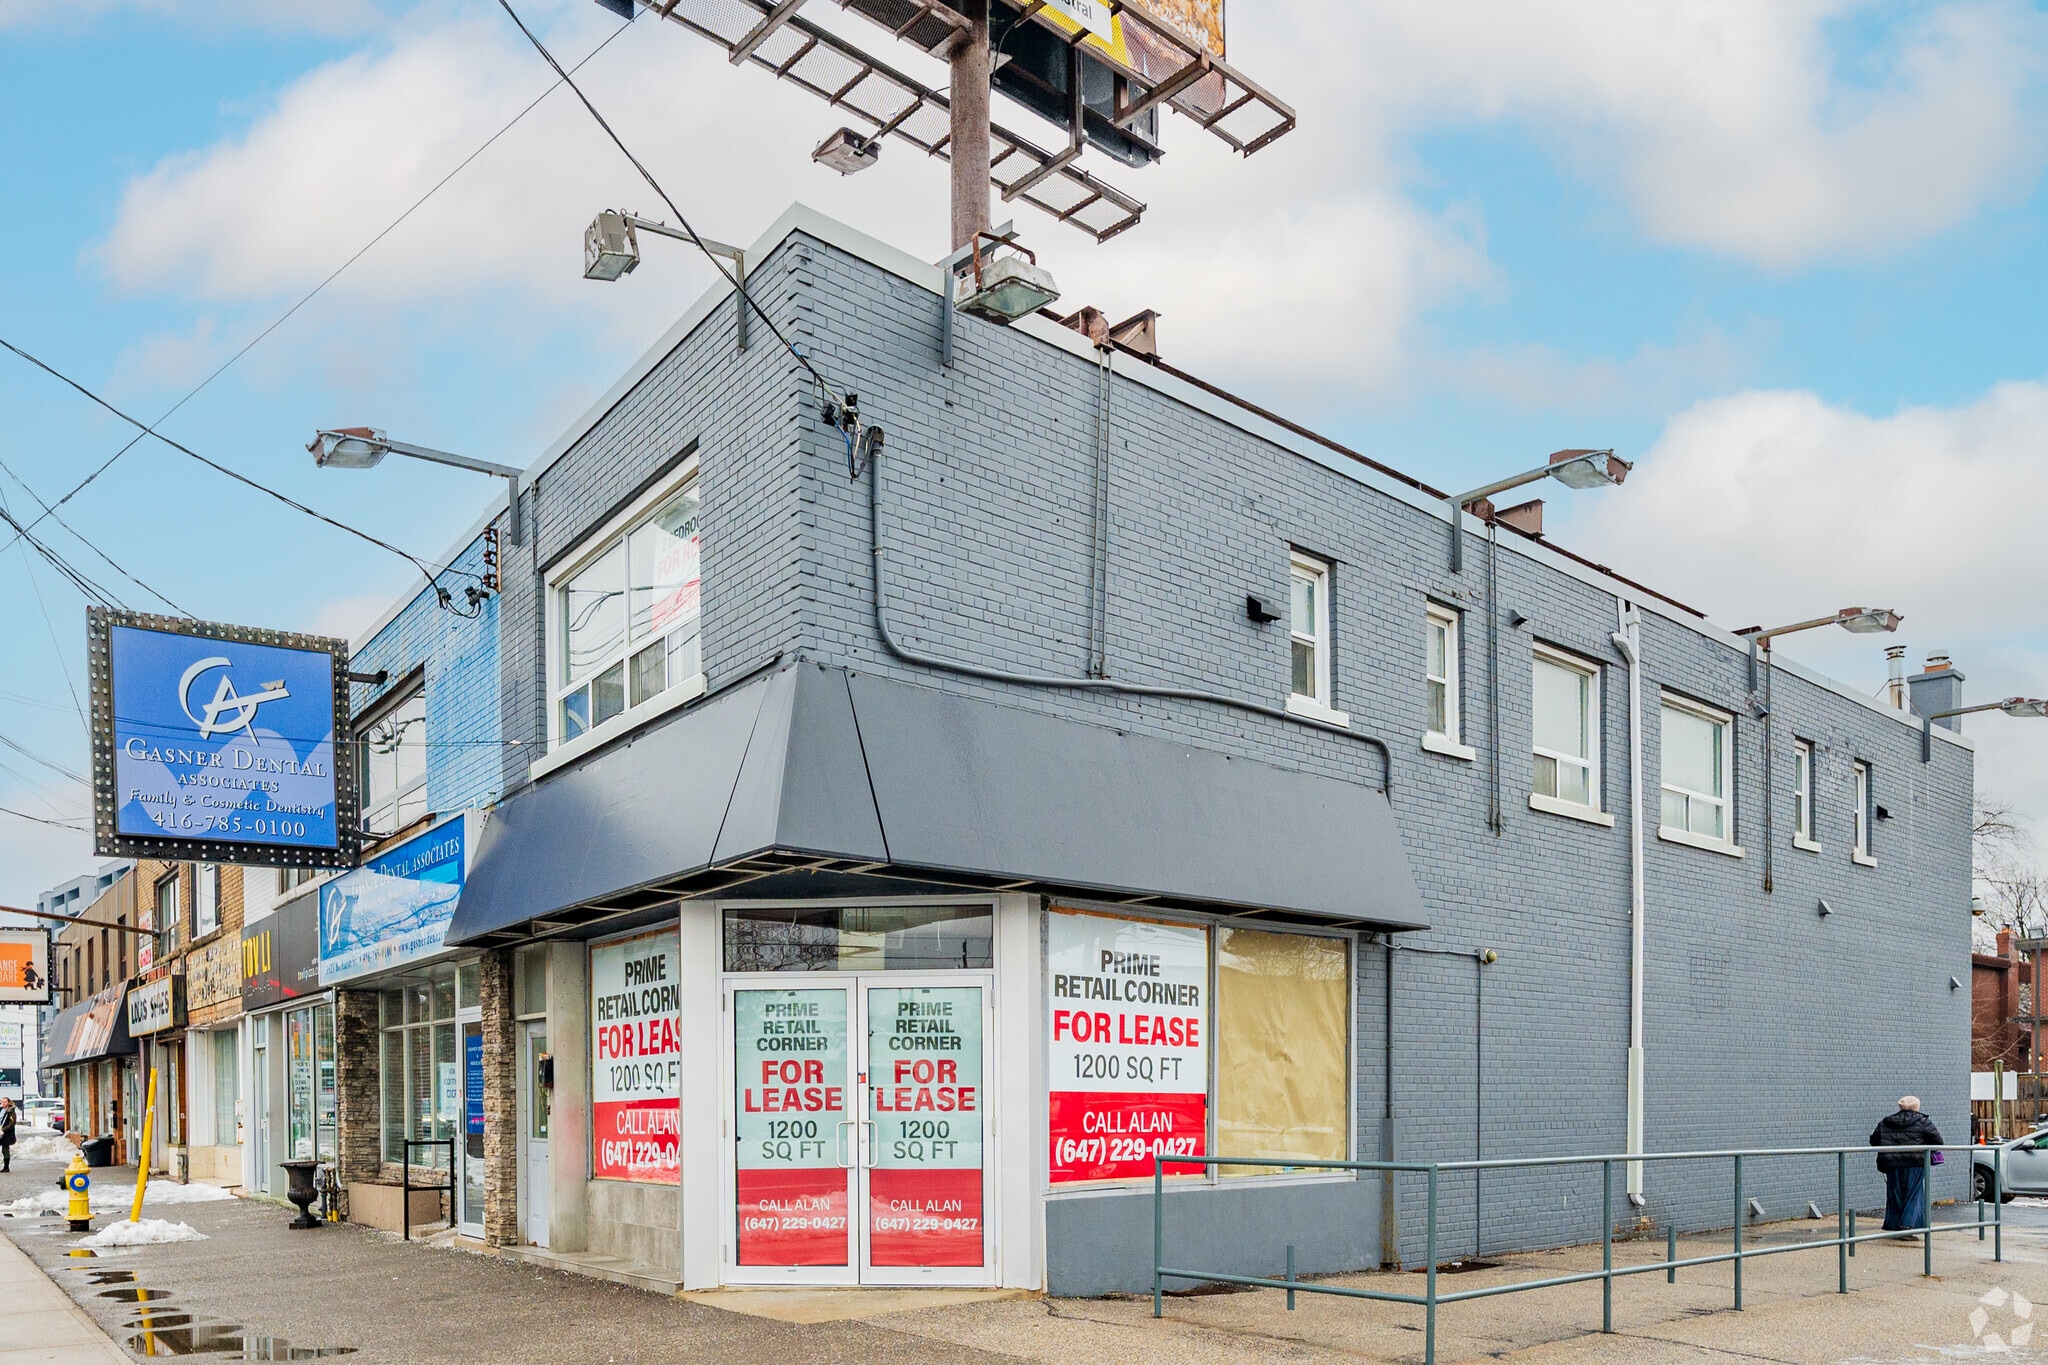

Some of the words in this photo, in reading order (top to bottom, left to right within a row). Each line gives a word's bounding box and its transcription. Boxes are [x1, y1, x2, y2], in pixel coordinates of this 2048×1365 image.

[177, 774, 279, 793] ASSOCIATES
[129, 788, 177, 809] Family
[182, 794, 196, 806] &
[201, 795, 261, 811] Cosmetic
[266, 800, 325, 820] Dentistry
[152, 811, 306, 837] 416-785-0100
[412, 836, 460, 872] ASSOCIATES
[242, 935, 259, 979] TOV
[261, 930, 271, 973] LI
[1101, 950, 1160, 977] PRIME
[625, 954, 666, 987] PRIME
[1055, 974, 1122, 1001] RETAIL
[1125, 979, 1199, 1007] CORNER
[598, 992, 640, 1021] RETAIL
[765, 1003, 819, 1017] PRIME
[898, 1002, 952, 1016] PRIME
[763, 1020, 821, 1034] RETAIL
[896, 1020, 955, 1033] RETAIL
[1054, 1010, 1111, 1043] FOR
[1119, 1014, 1199, 1047] LEASE
[599, 1023, 634, 1059] FOR
[757, 1037, 828, 1051] CORNER
[889, 1036, 961, 1050] CORNER
[611, 1064, 640, 1092] 1200
[644, 1062, 664, 1093] SQ
[668, 1061, 680, 1089] F
[762, 1060, 824, 1084] FOR
[894, 1060, 957, 1084] FOR
[1074, 1054, 1120, 1080] 1200
[1126, 1056, 1153, 1083] SQ
[1160, 1057, 1182, 1080] FT
[745, 1087, 843, 1112] LEASE
[876, 1087, 976, 1112] LEASE
[617, 1110, 645, 1134] CALL
[648, 1110, 680, 1134] ALAN
[768, 1121, 818, 1138] 1200
[900, 1121, 950, 1138] 1200
[1083, 1111, 1126, 1134] CALL
[1129, 1112, 1173, 1133] ALAN
[601, 1138, 633, 1170] (647)
[762, 1141, 792, 1161] SQ
[800, 1141, 825, 1158] FT
[893, 1141, 924, 1161] SQ
[932, 1141, 958, 1158] FT
[1055, 1137, 1106, 1166] (647)
[1110, 1138, 1196, 1161] 229-0427
[759, 1199, 792, 1211] CALL
[795, 1199, 830, 1211] ALAN
[891, 1199, 924, 1212] CALL
[926, 1199, 962, 1211] ALAN
[745, 1217, 779, 1231] (647)
[783, 1216, 846, 1230] 229-0427
[876, 1216, 910, 1231] (647)
[913, 1217, 978, 1231] 229-0427
